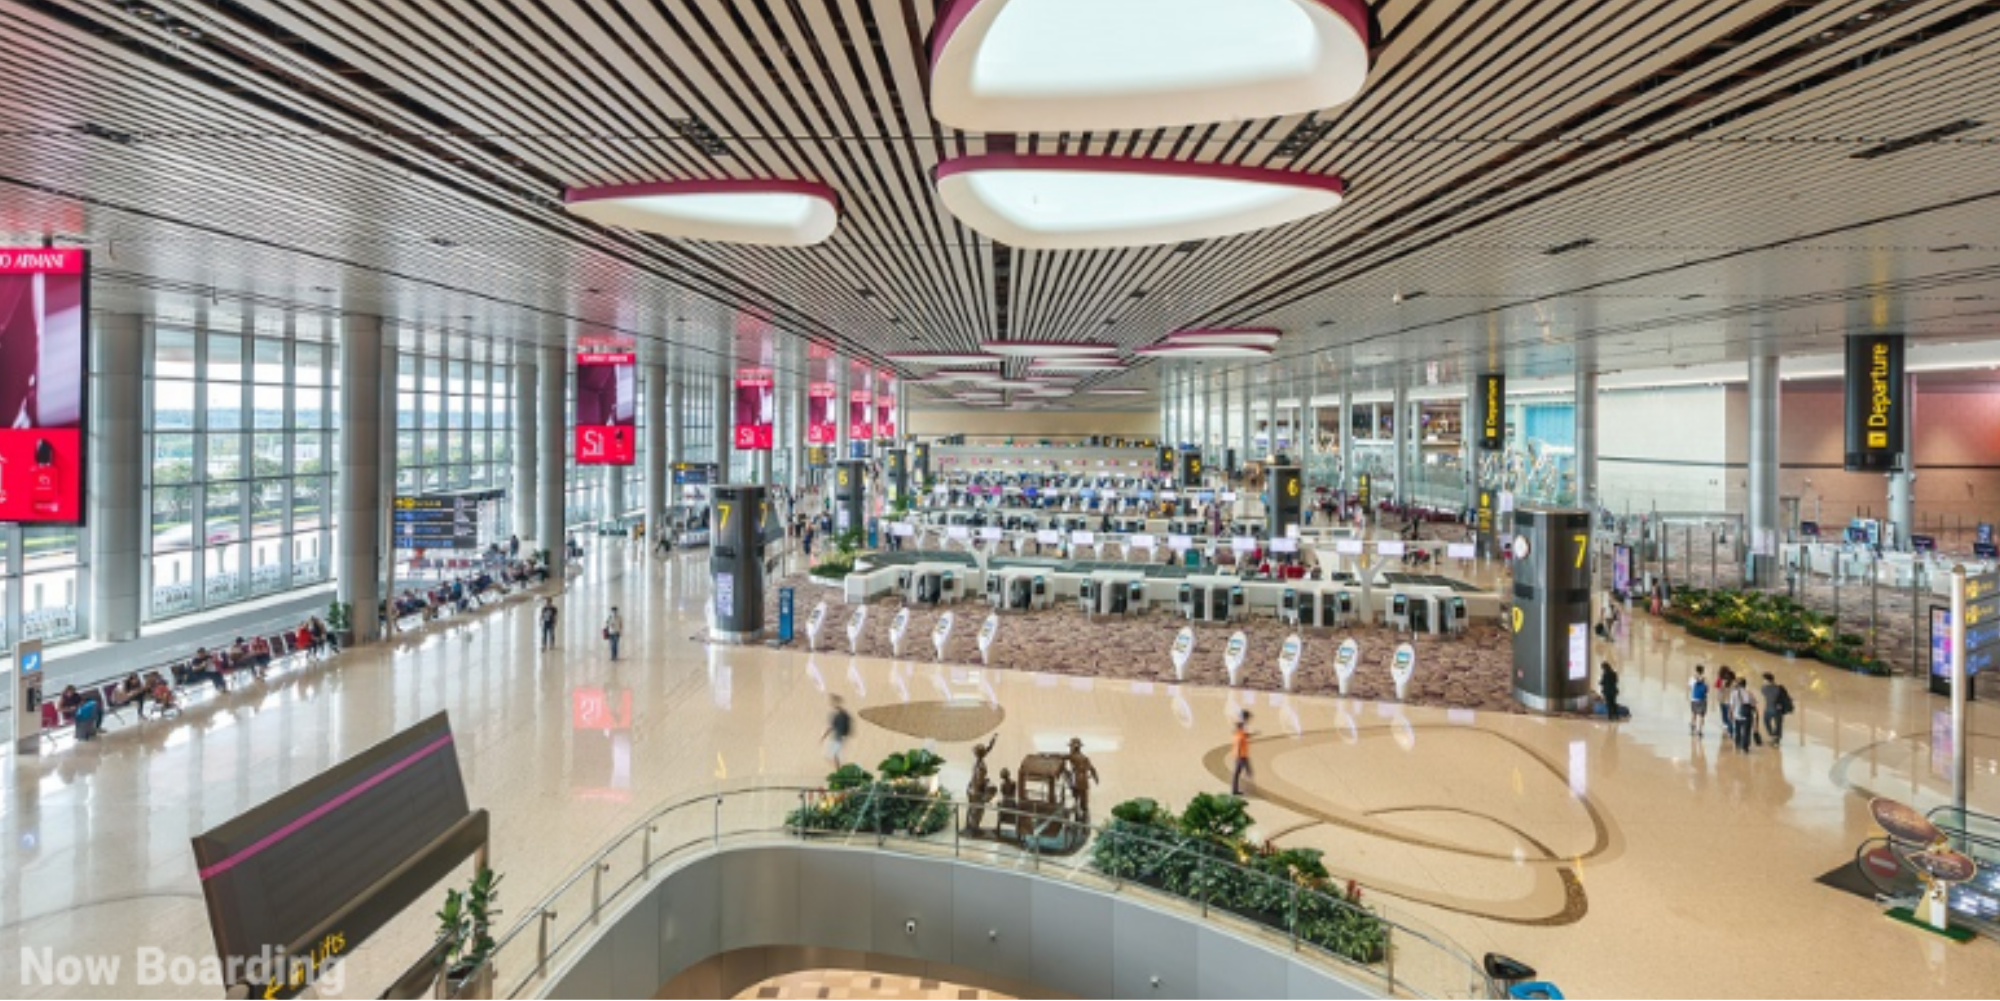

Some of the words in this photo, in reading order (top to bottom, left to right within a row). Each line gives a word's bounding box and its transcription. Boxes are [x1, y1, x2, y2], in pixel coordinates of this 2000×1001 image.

[13, 254, 64, 268] ARMANI
[1867, 343, 1891, 427] Departure
[838, 467, 849, 486] 6
[1286, 477, 1299, 497] 6
[717, 504, 731, 531] 7
[1572, 534, 1588, 569] 7
